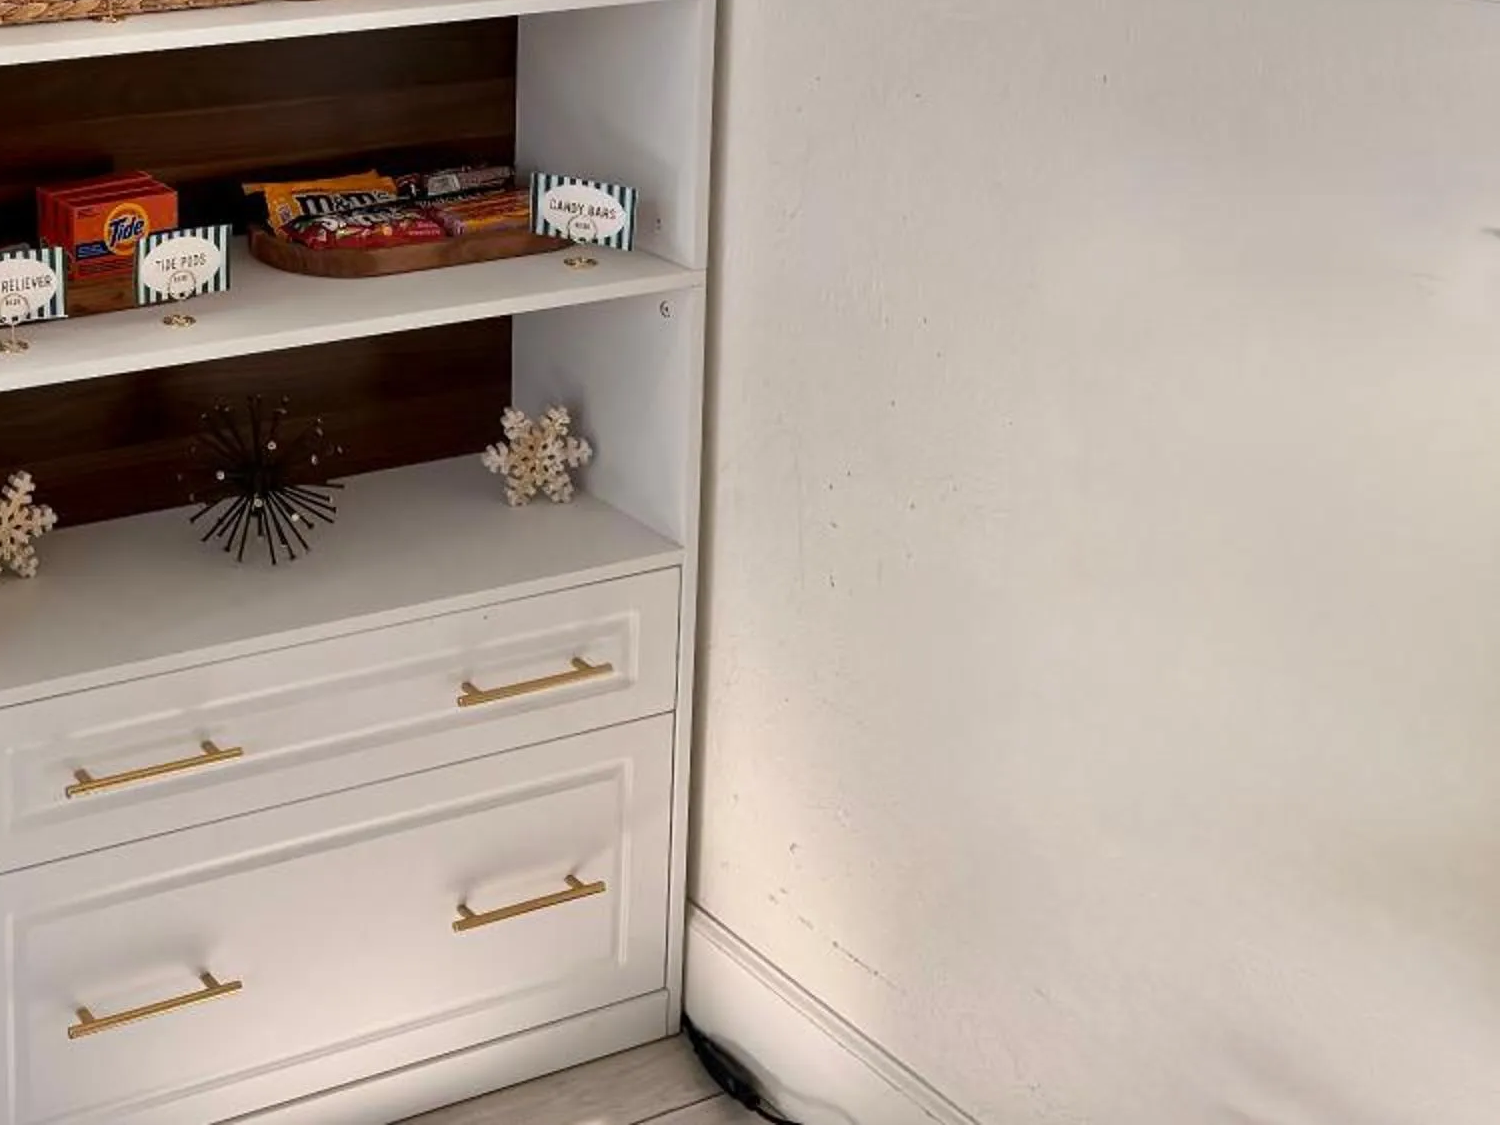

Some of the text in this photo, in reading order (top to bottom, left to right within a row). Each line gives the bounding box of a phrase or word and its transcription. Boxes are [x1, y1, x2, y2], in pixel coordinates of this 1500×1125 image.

[549, 197, 618, 220] CANDY BARS
[109, 216, 145, 248] Tide
[155, 252, 207, 272] TIDE PODS
[1, 274, 52, 294] RELIEVER
